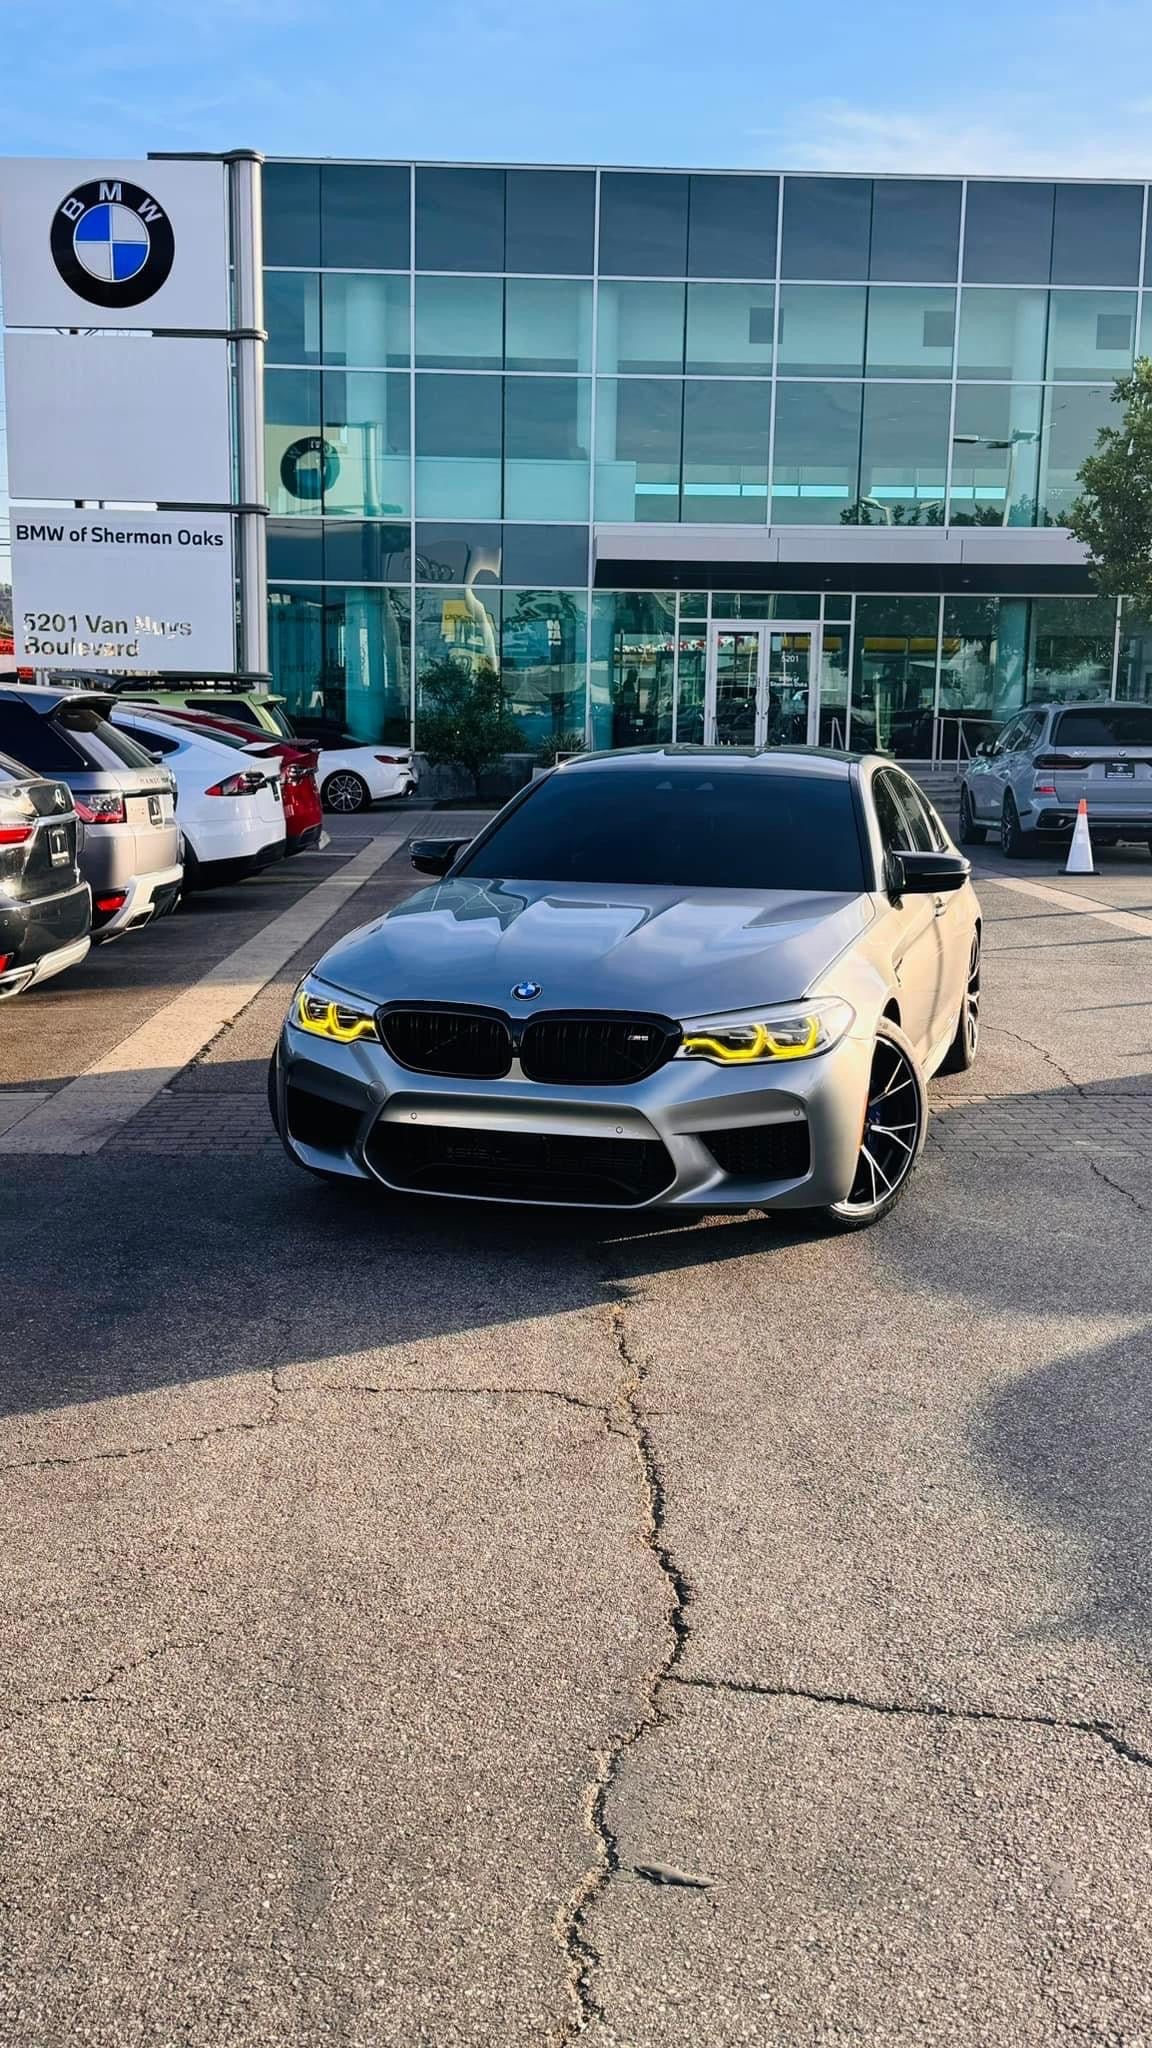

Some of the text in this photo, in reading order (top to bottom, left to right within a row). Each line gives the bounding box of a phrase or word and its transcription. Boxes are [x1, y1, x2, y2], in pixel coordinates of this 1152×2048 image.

[60, 182, 163, 223] BMW
[16, 525, 224, 546] BMW of Sherman Oaks
[23, 613, 77, 632] 5201
[86, 615, 128, 634] Van
[25, 636, 139, 657] Boulevard
